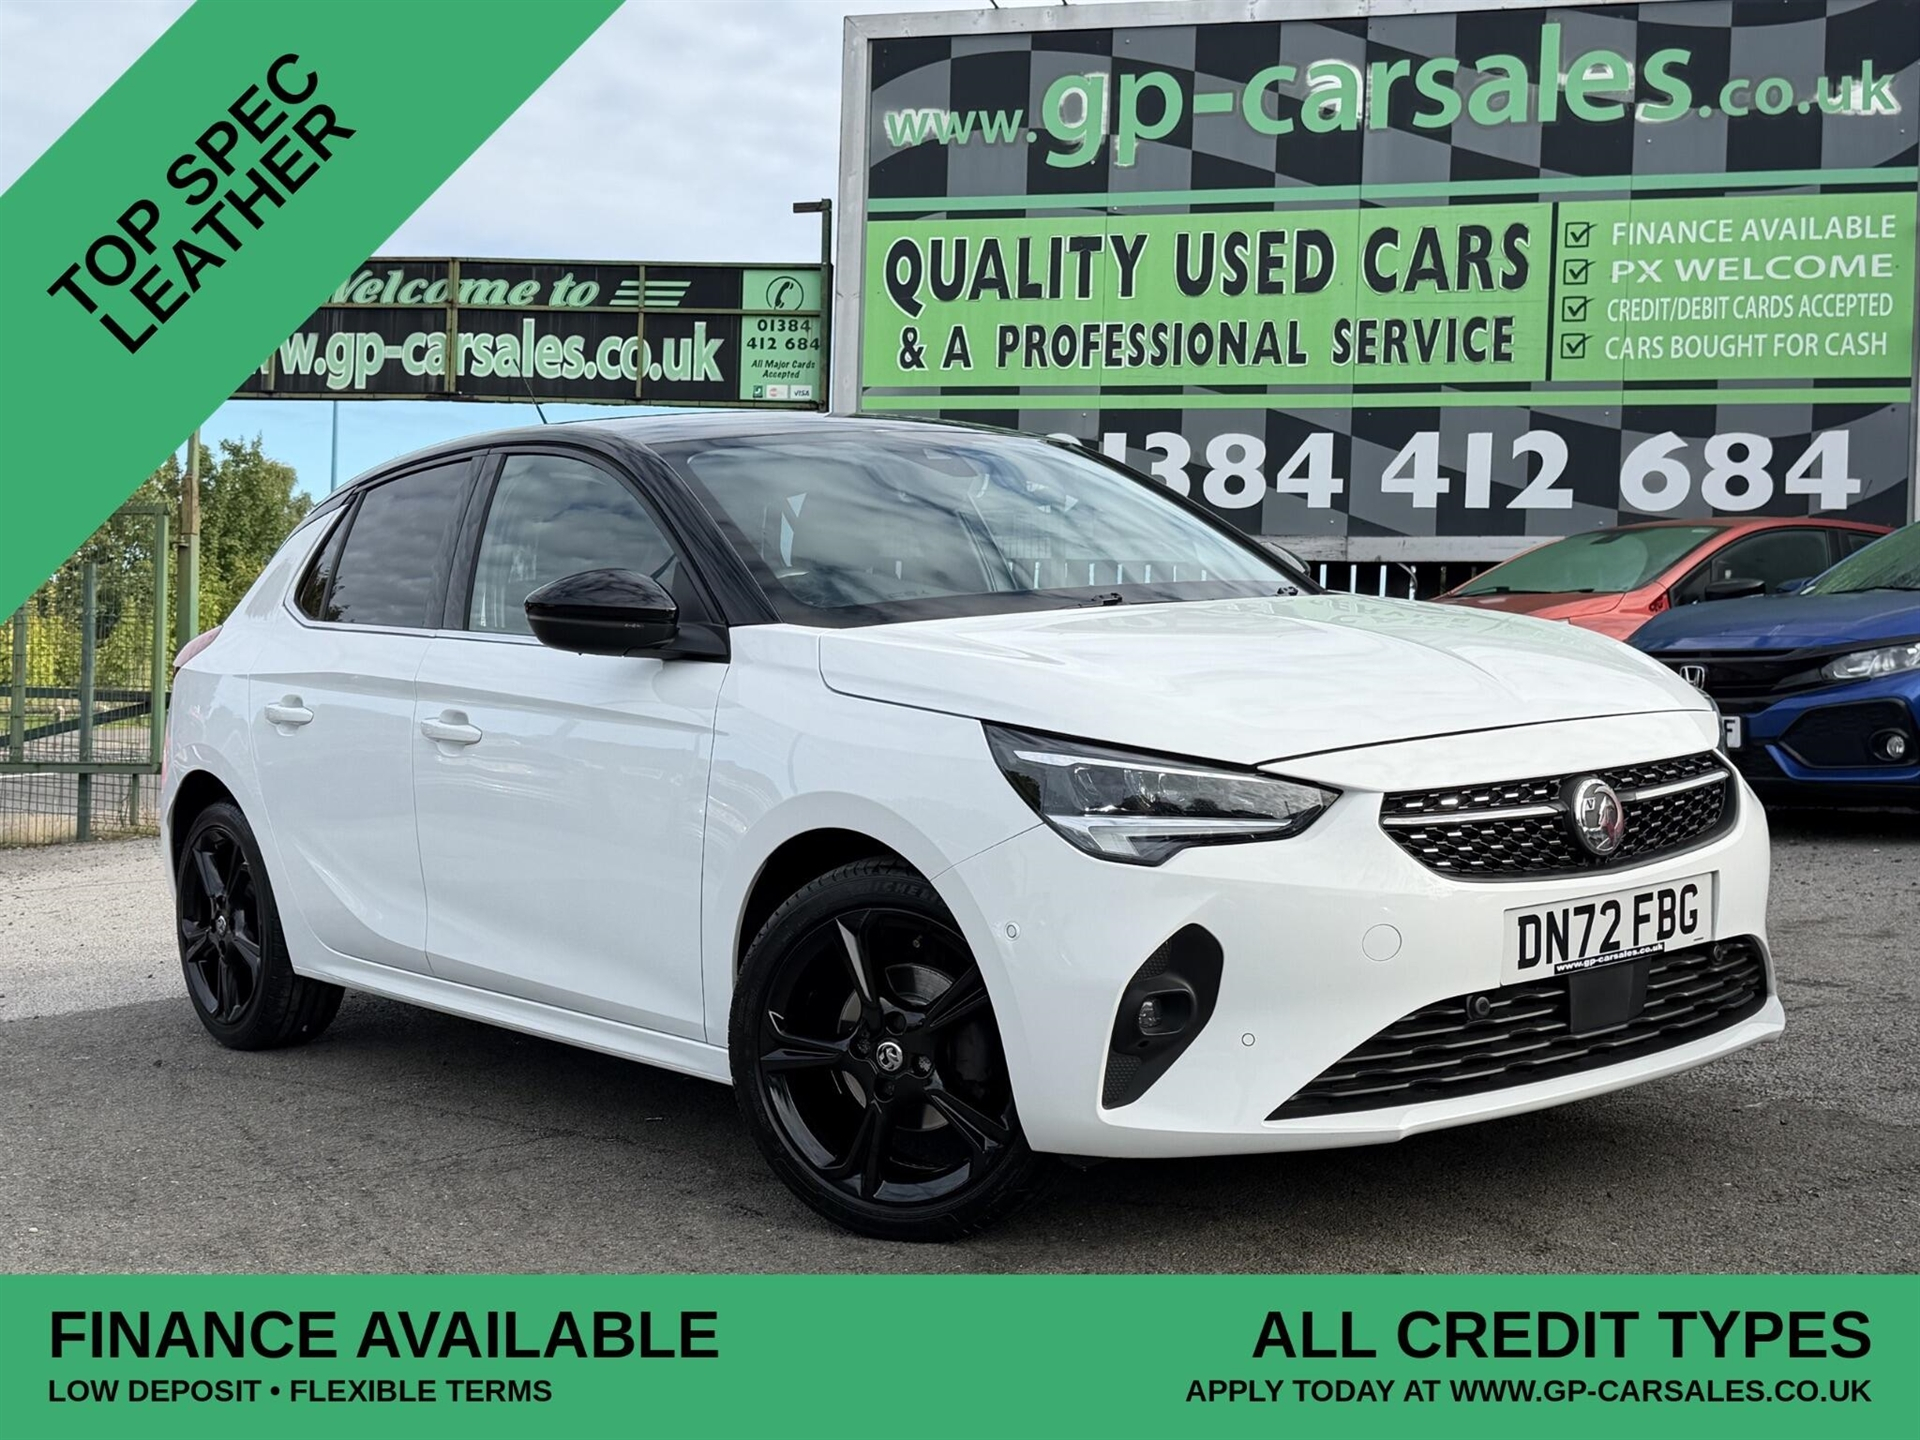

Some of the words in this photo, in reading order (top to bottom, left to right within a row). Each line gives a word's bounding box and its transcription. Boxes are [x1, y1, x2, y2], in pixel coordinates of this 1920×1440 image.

[885, 23, 1900, 168] www.gp-carsales.co.uk
[1612, 219, 1733, 246] FINANCE
[1741, 214, 1896, 242] AVAILABLE
[885, 233, 1149, 318] QUALITY
[1174, 227, 1337, 297] USED
[1362, 222, 1531, 294] CARS
[1611, 259, 1663, 283] PX
[1674, 253, 1893, 282] WELCOME
[548, 272, 600, 307] to
[1607, 296, 1730, 322] CREDIT/DEBIT
[1733, 294, 1793, 319] CARDS
[1798, 292, 1893, 318] ACCEPTED
[757, 318, 811, 332] 01384
[253, 318, 725, 390] w.gp-carsales.co.uk
[747, 337, 777, 350] 412
[785, 337, 820, 351] 684
[898, 326, 928, 371] &
[940, 324, 972, 370] A
[996, 320, 1308, 370] PROFESSIONAL
[1331, 316, 1516, 365] SERVICE
[1605, 335, 1663, 360] CARS
[1671, 333, 1767, 359] BOUGHT
[1773, 332, 1818, 357] FOR
[1825, 331, 1888, 356] CASH
[751, 359, 763, 368] All
[764, 359, 790, 370] Major
[792, 359, 816, 369] Cards
[762, 370, 801, 380] Accepted
[1381, 431, 1573, 508] 412
[1620, 429, 1862, 512] 684
[1517, 899, 1621, 970] DN72
[1633, 883, 1698, 947] FBG
[1556, 943, 1663, 972] www.gp-carsales.co.uk
